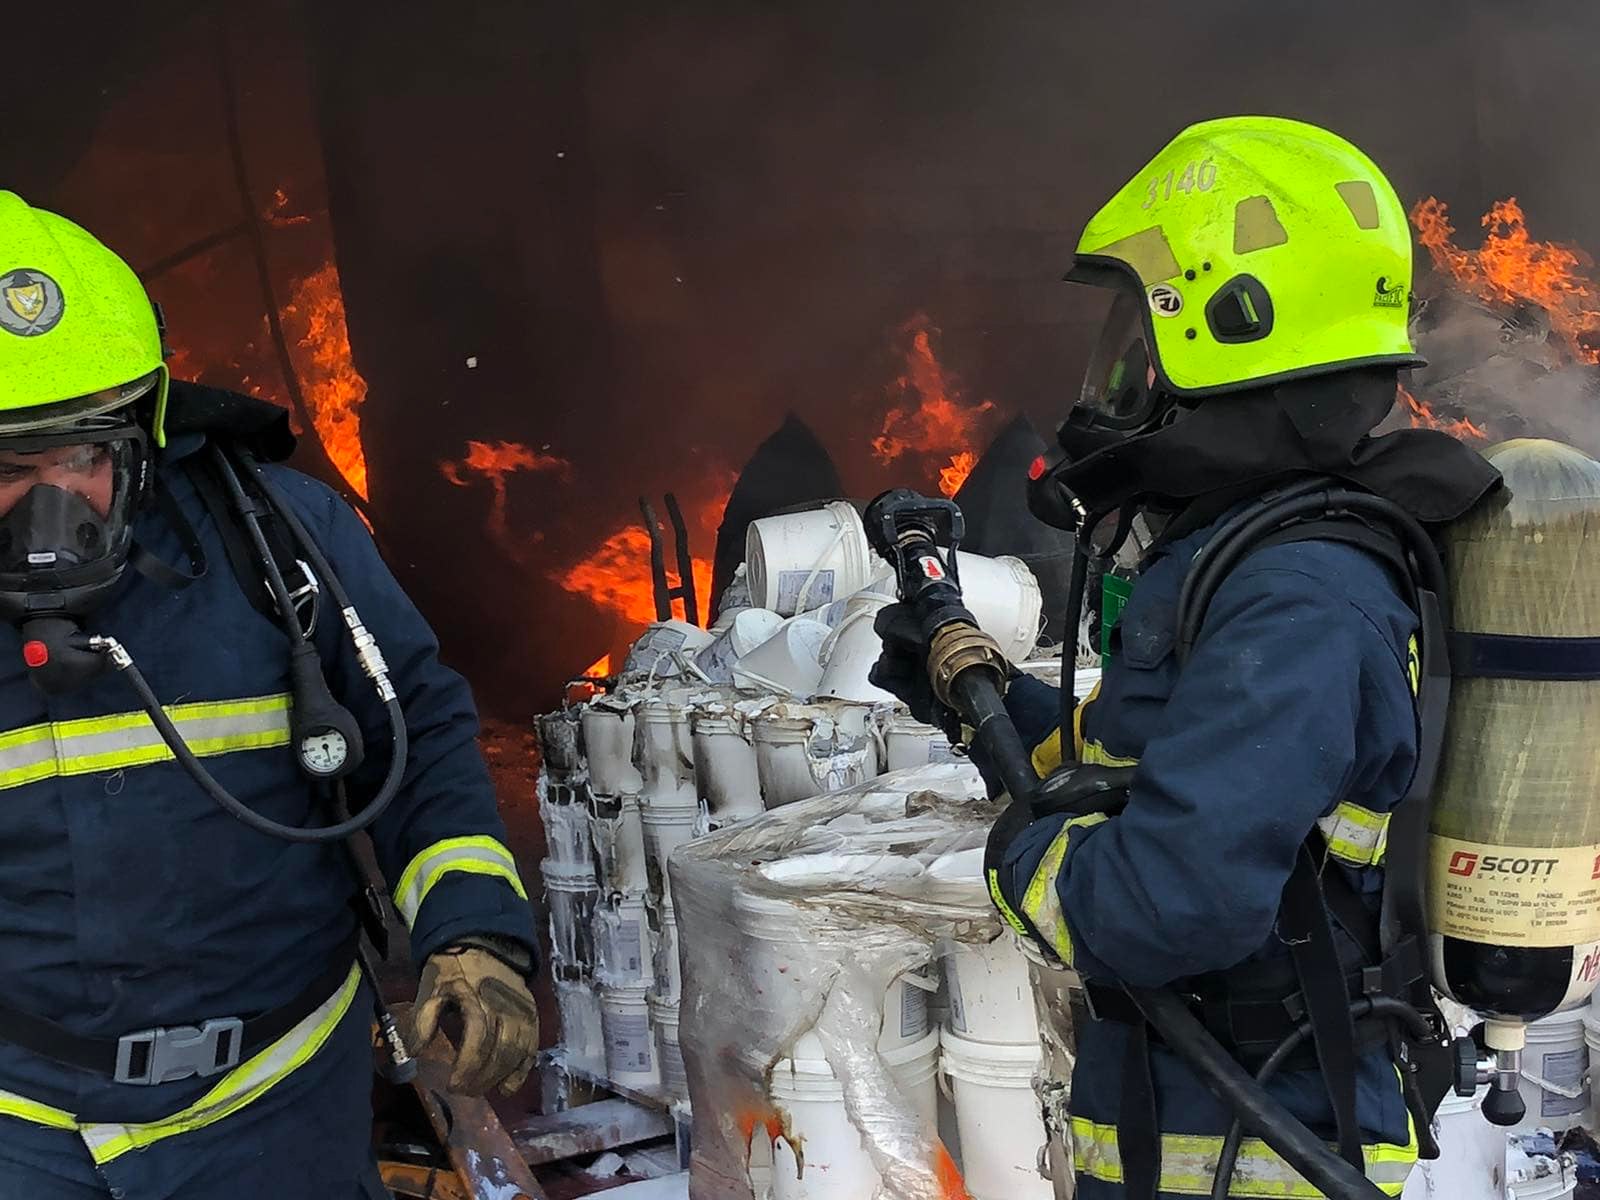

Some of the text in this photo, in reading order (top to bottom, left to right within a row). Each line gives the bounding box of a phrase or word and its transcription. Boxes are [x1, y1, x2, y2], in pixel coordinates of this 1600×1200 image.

[1141, 159, 1217, 209] 3140
[1480, 856, 1559, 874] SCOTT
[1477, 873, 1548, 883] SAFETY
